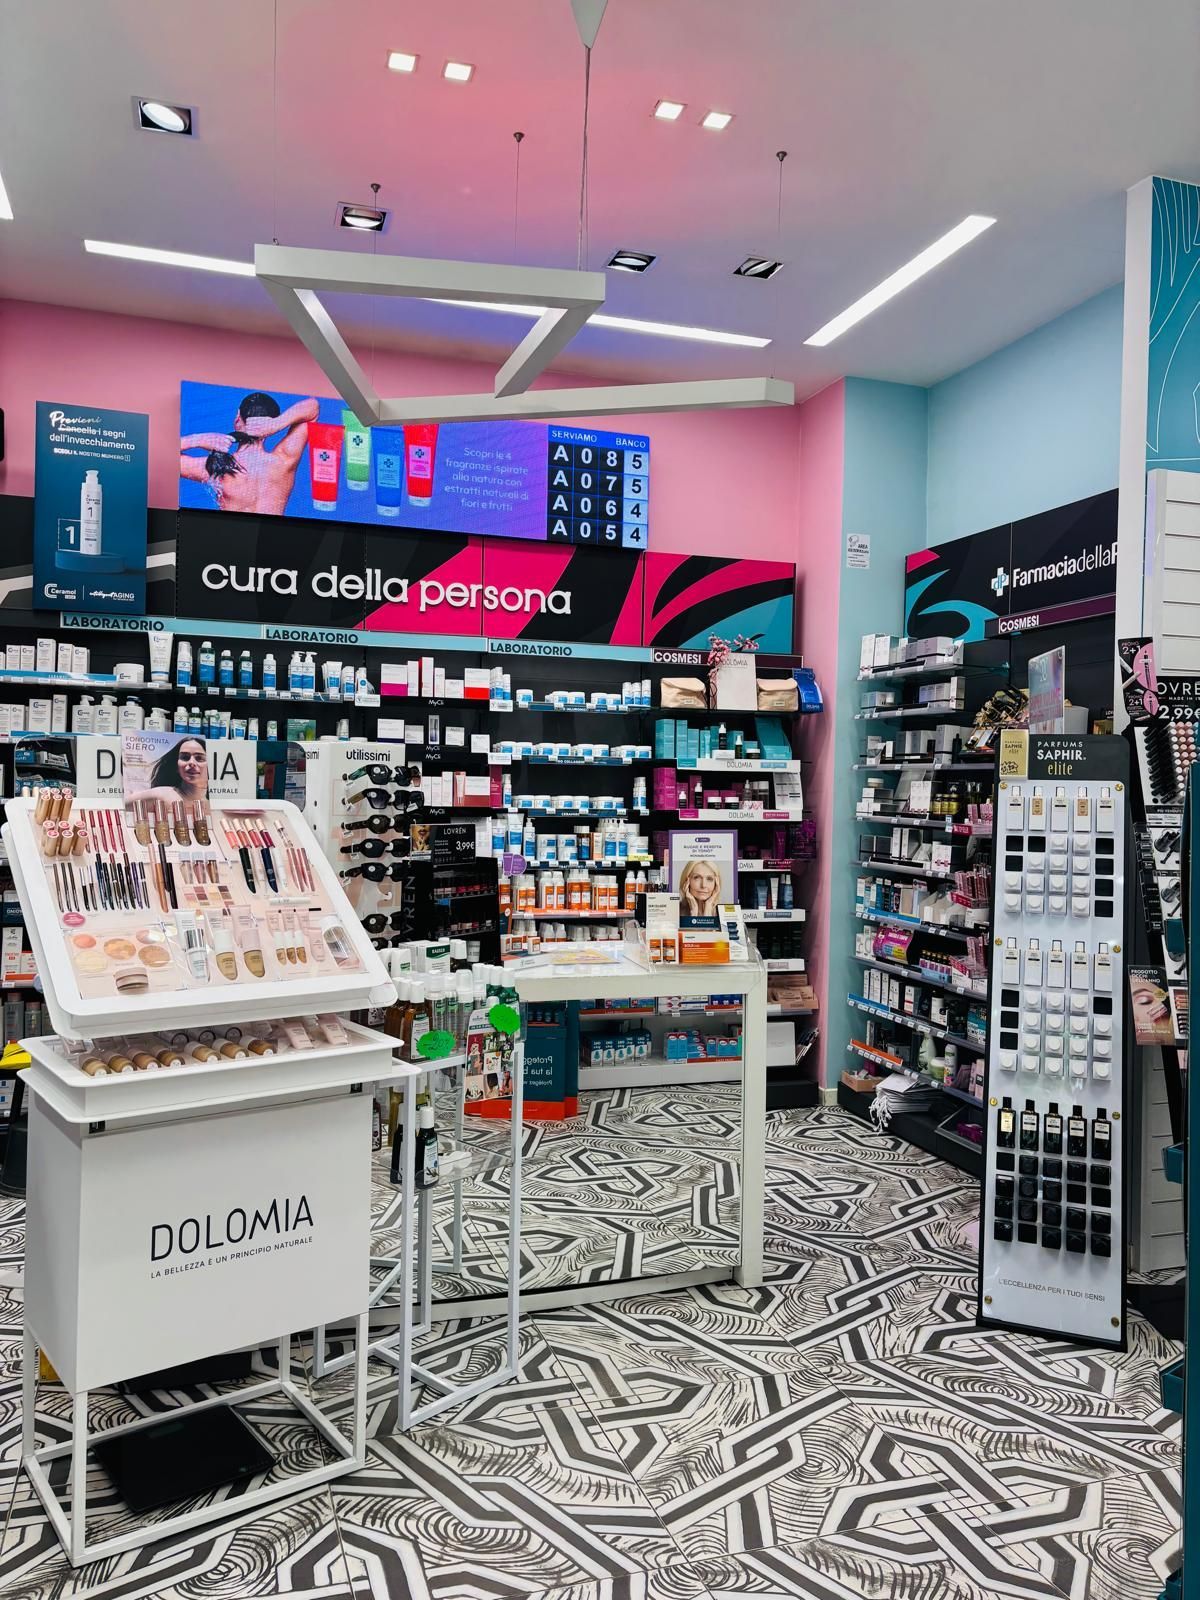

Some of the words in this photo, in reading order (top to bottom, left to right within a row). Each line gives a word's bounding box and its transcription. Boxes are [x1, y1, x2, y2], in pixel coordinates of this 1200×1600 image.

[49, 433, 135, 450] dell'invecchiamento
[102, 429, 126, 439] segni
[552, 430, 598, 443] SERVIAMO
[615, 438, 646, 449] BANCO
[463, 447, 494, 461] Scopri
[553, 445, 569, 462] A
[606, 450, 618, 467] 8
[632, 454, 642, 470] 5
[446, 458, 492, 472] fragranze
[494, 464, 529, 475] ispirate
[452, 472, 470, 481] alla
[471, 476, 503, 486] natura
[505, 479, 523, 487] con
[553, 470, 569, 487] A
[605, 475, 618, 491] 7
[631, 478, 642, 494] 5
[444, 485, 481, 496] estratti
[482, 488, 519, 500] naturali
[520, 491, 529, 501] di
[461, 498, 480, 508] fiori
[488, 500, 513, 511] frutti
[552, 495, 568, 511] A
[605, 500, 617, 516] 6
[630, 503, 642, 518] 4
[65, 526, 75, 545] 1
[551, 520, 568, 536] A
[605, 525, 617, 540] 5
[630, 527, 641, 542] 4
[201, 562, 298, 595] cura
[311, 565, 409, 602] della
[419, 579, 572, 614] persona
[63, 616, 165, 632] LABORATORIO
[1000, 615, 1040, 633] COSMESI
[265, 628, 359, 644] LABORATORIO
[490, 642, 572, 657] LABORATORIO
[654, 651, 702, 664] COSMESI
[125, 736, 170, 745] FONDOTINTA
[125, 743, 155, 751] SIERO
[346, 748, 391, 762] utilissimi
[1047, 761, 1073, 775] elite
[456, 840, 475, 851] 3,99€
[151, 1194, 314, 1262] DOLOMIA
[151, 1270, 161, 1279] LA
[164, 1260, 206, 1276] BELLEZZA
[207, 1257, 213, 1266] È
[216, 1254, 228, 1264] UN
[230, 1245, 272, 1260] PRINCIPIO
[274, 1236, 313, 1251] NATURALE
[998, 1278, 1046, 1292] L'ECCELLENZA
[1047, 1286, 1061, 1294] PER
[1066, 1289, 1083, 1299] TUOI
[1084, 1294, 1106, 1302] SENSI
